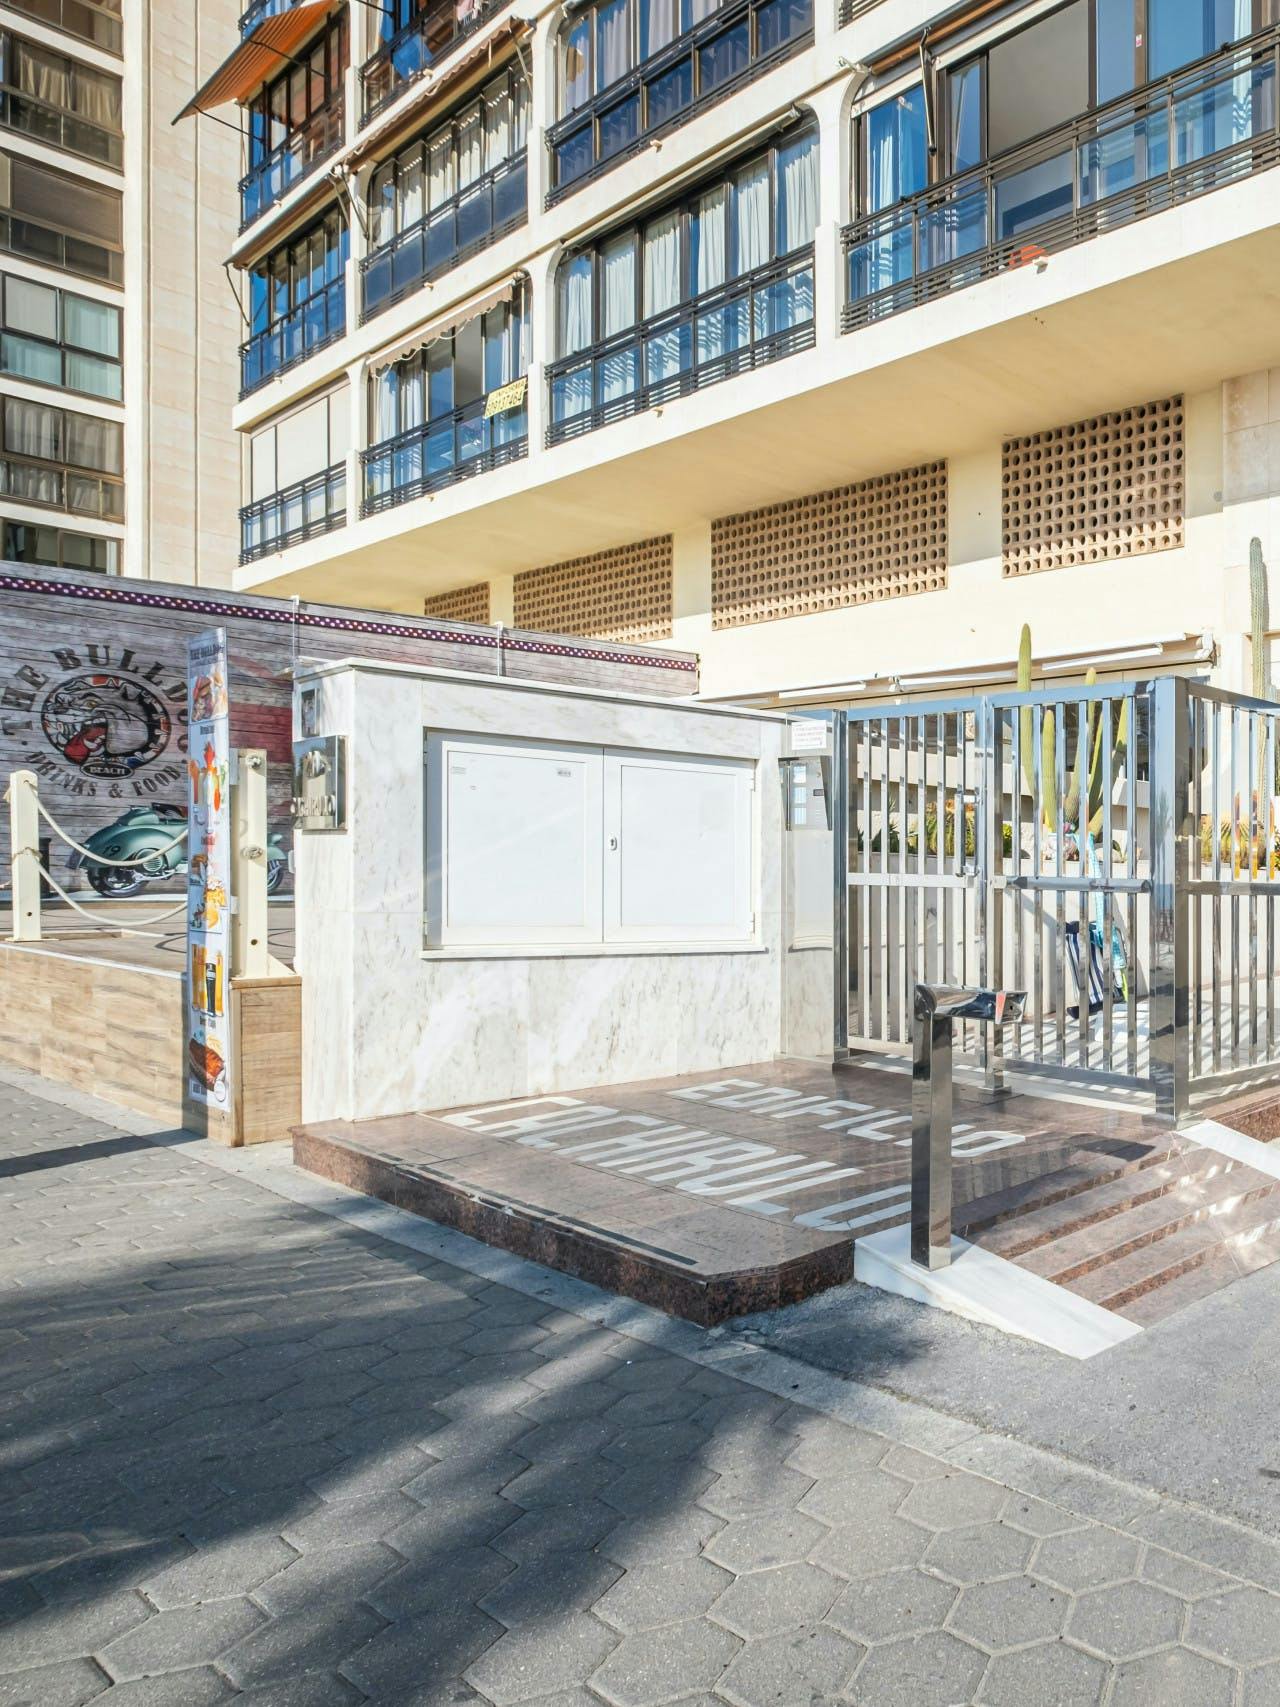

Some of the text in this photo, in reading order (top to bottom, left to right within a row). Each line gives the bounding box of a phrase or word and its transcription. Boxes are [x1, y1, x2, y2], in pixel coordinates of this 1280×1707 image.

[1, 664, 49, 735] THE
[25, 751, 181, 799] DRINKS & FOOD
[90, 765, 126, 775] BEACH
[667, 1079, 1026, 1158] EDIFICIO
[442, 1097, 912, 1231] CACHIRULO
